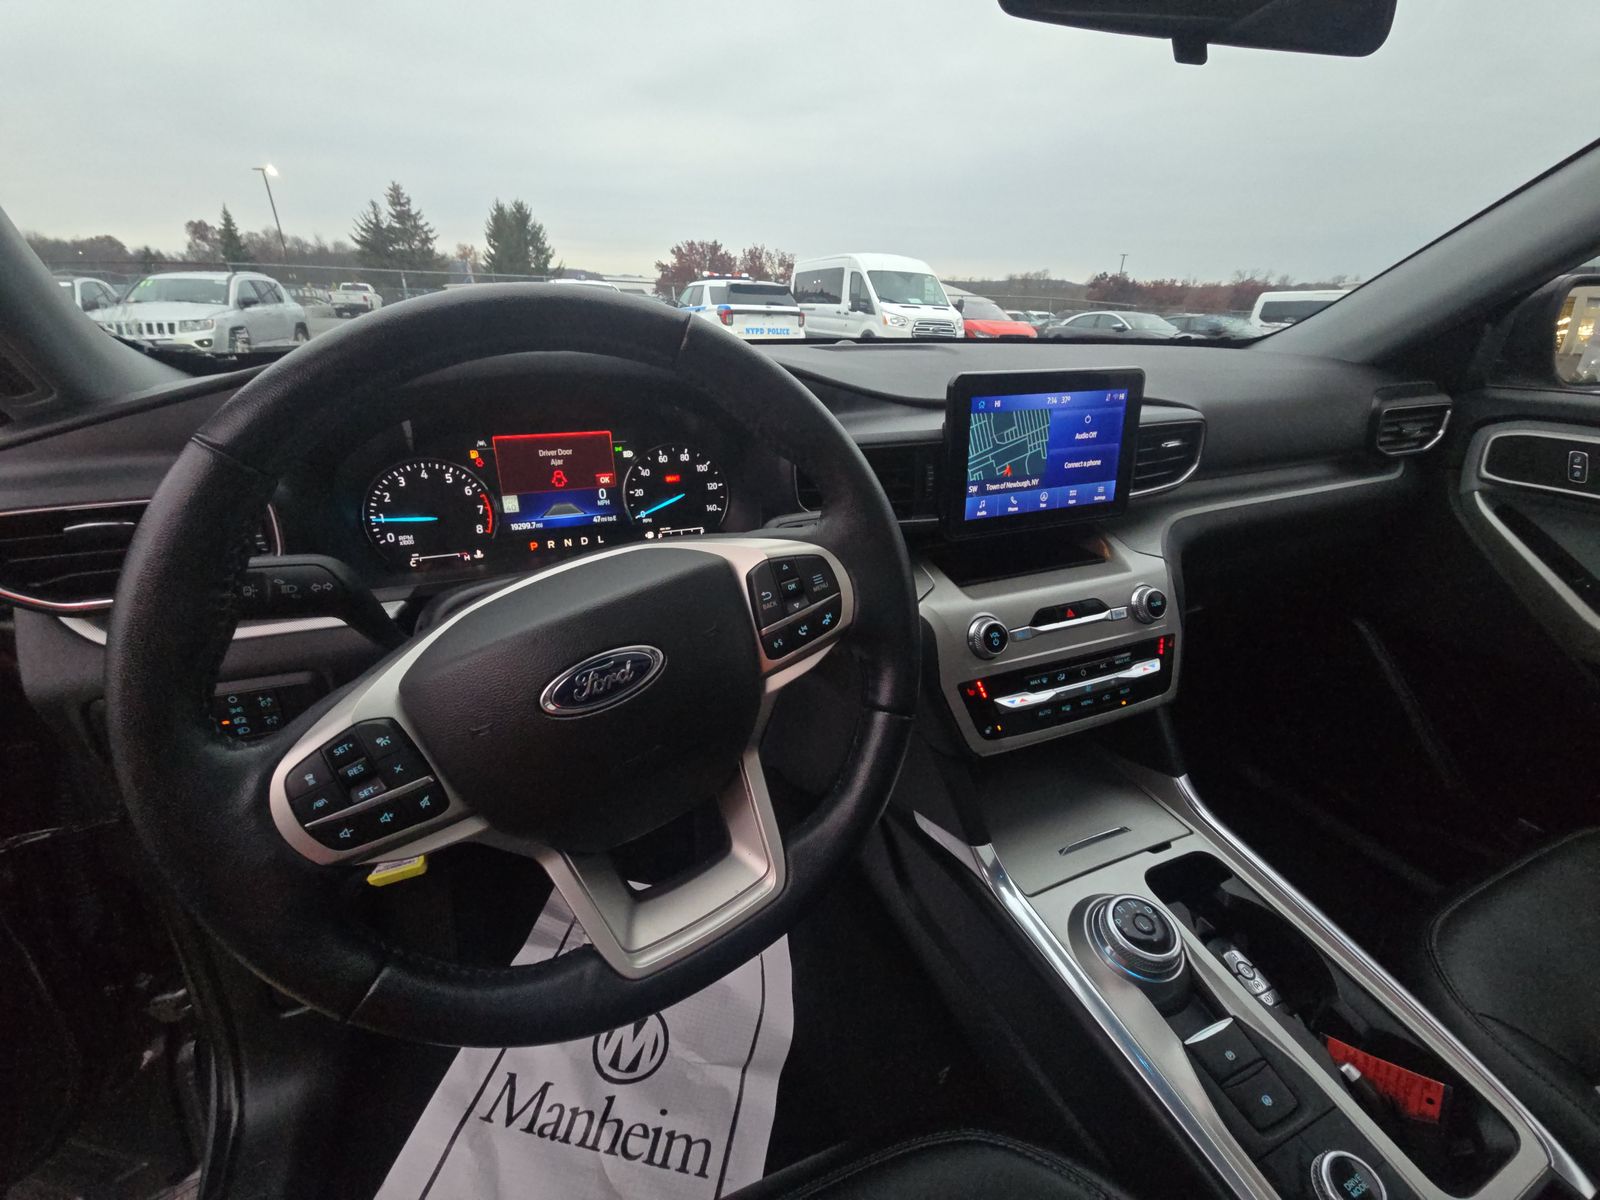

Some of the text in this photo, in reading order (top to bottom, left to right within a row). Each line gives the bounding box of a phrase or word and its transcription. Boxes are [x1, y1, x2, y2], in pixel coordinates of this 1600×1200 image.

[745, 327, 790, 335] NYPD POLICE
[1075, 432, 1088, 440] Audio
[538, 448, 573, 457] Driver Door
[680, 453, 690, 461] 80
[658, 455, 668, 463] 60
[1064, 461, 1083, 469] Connect
[1087, 459, 1102, 468] phone
[420, 470, 428, 479] 4
[445, 473, 453, 483] 5
[640, 469, 650, 477] 40
[398, 476, 405, 486] 3
[464, 486, 472, 496] 6
[598, 488, 606, 499] 0
[383, 492, 391, 502] 2
[477, 505, 483, 514] 7
[476, 524, 483, 534] 8
[510, 522, 536, 531] 19299.7
[386, 533, 395, 543] 0
[530, 542, 538, 551] P
[548, 540, 555, 549] R
[564, 538, 572, 547] N
[580, 537, 588, 545] D
[787, 583, 797, 591] OK
[573, 659, 635, 701] Ford
[333, 742, 353, 757] SET+
[347, 764, 365, 777] RES
[1117, 906, 1126, 914] R
[1115, 919, 1122, 927] P
[1140, 922, 1148, 930] L
[479, 1072, 712, 1179] Manheim
[1343, 1173, 1361, 1191] DRIVE
[1350, 1181, 1370, 1198] MODE
